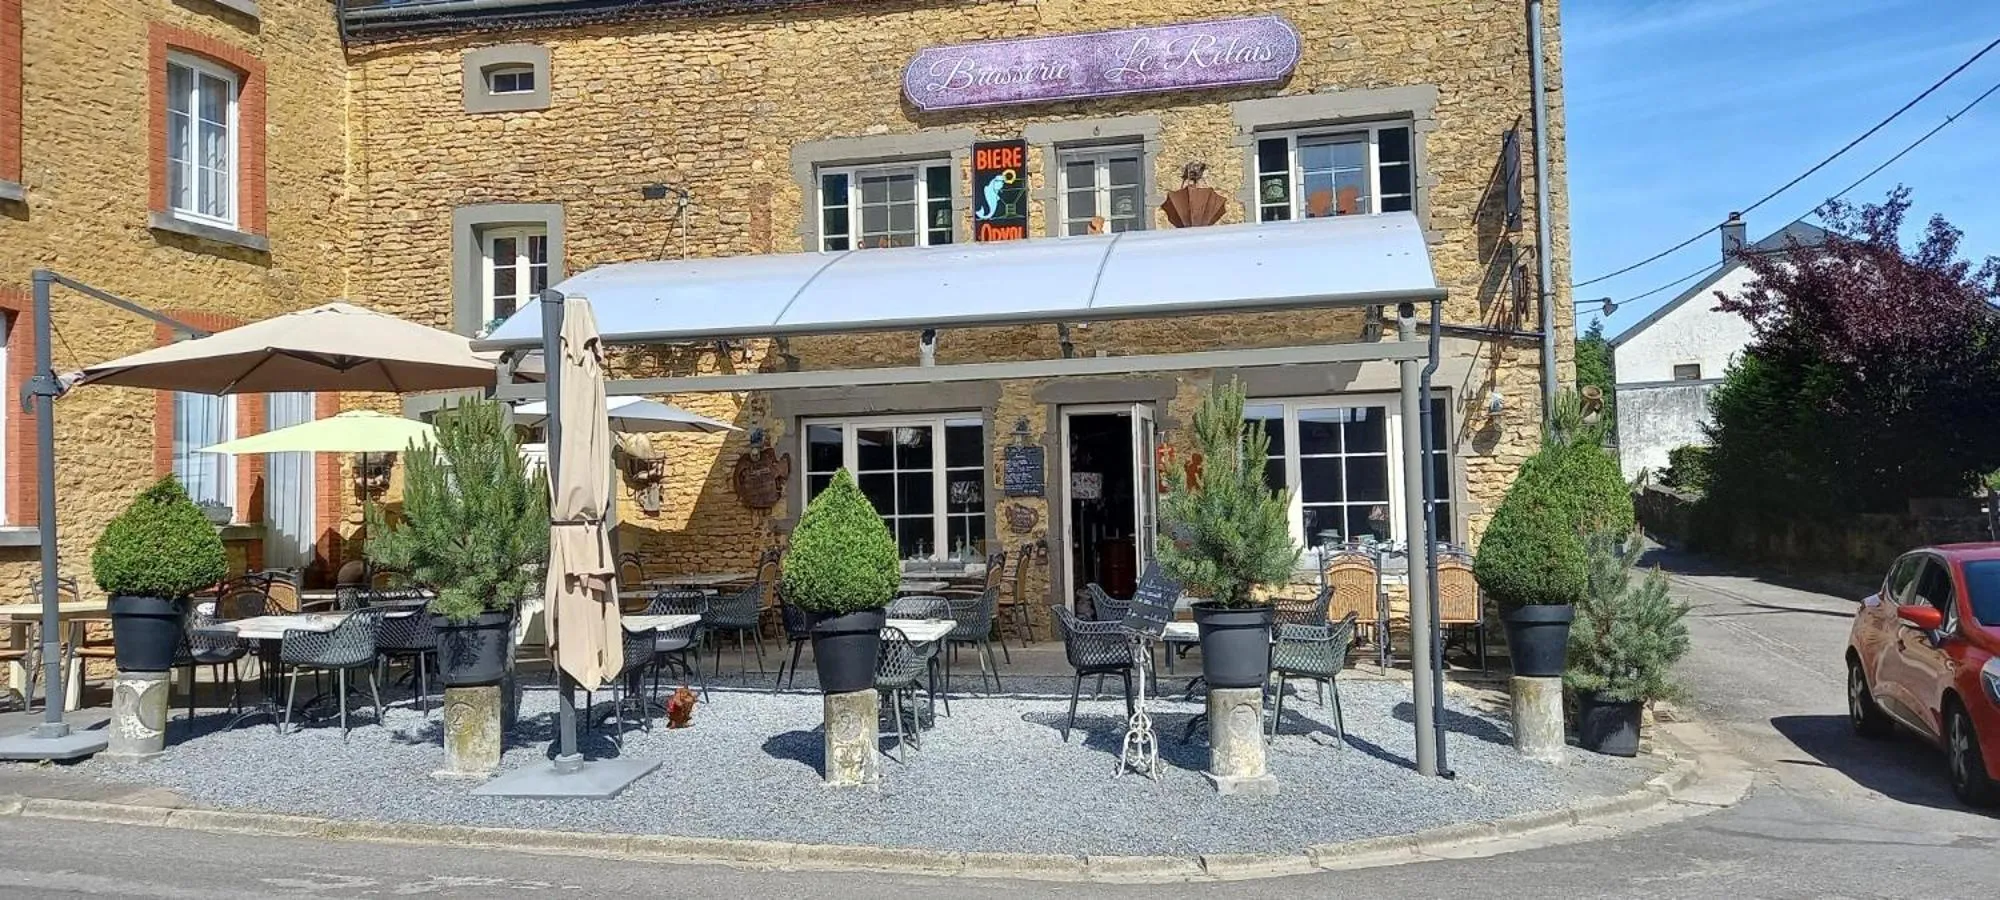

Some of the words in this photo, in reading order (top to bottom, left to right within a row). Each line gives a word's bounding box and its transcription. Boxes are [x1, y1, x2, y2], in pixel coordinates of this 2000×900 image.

[927, 55, 1071, 92] Brasserie
[1103, 37, 1153, 83] Le
[1166, 34, 1275, 70] Relais
[976, 147, 1022, 170] BIERE
